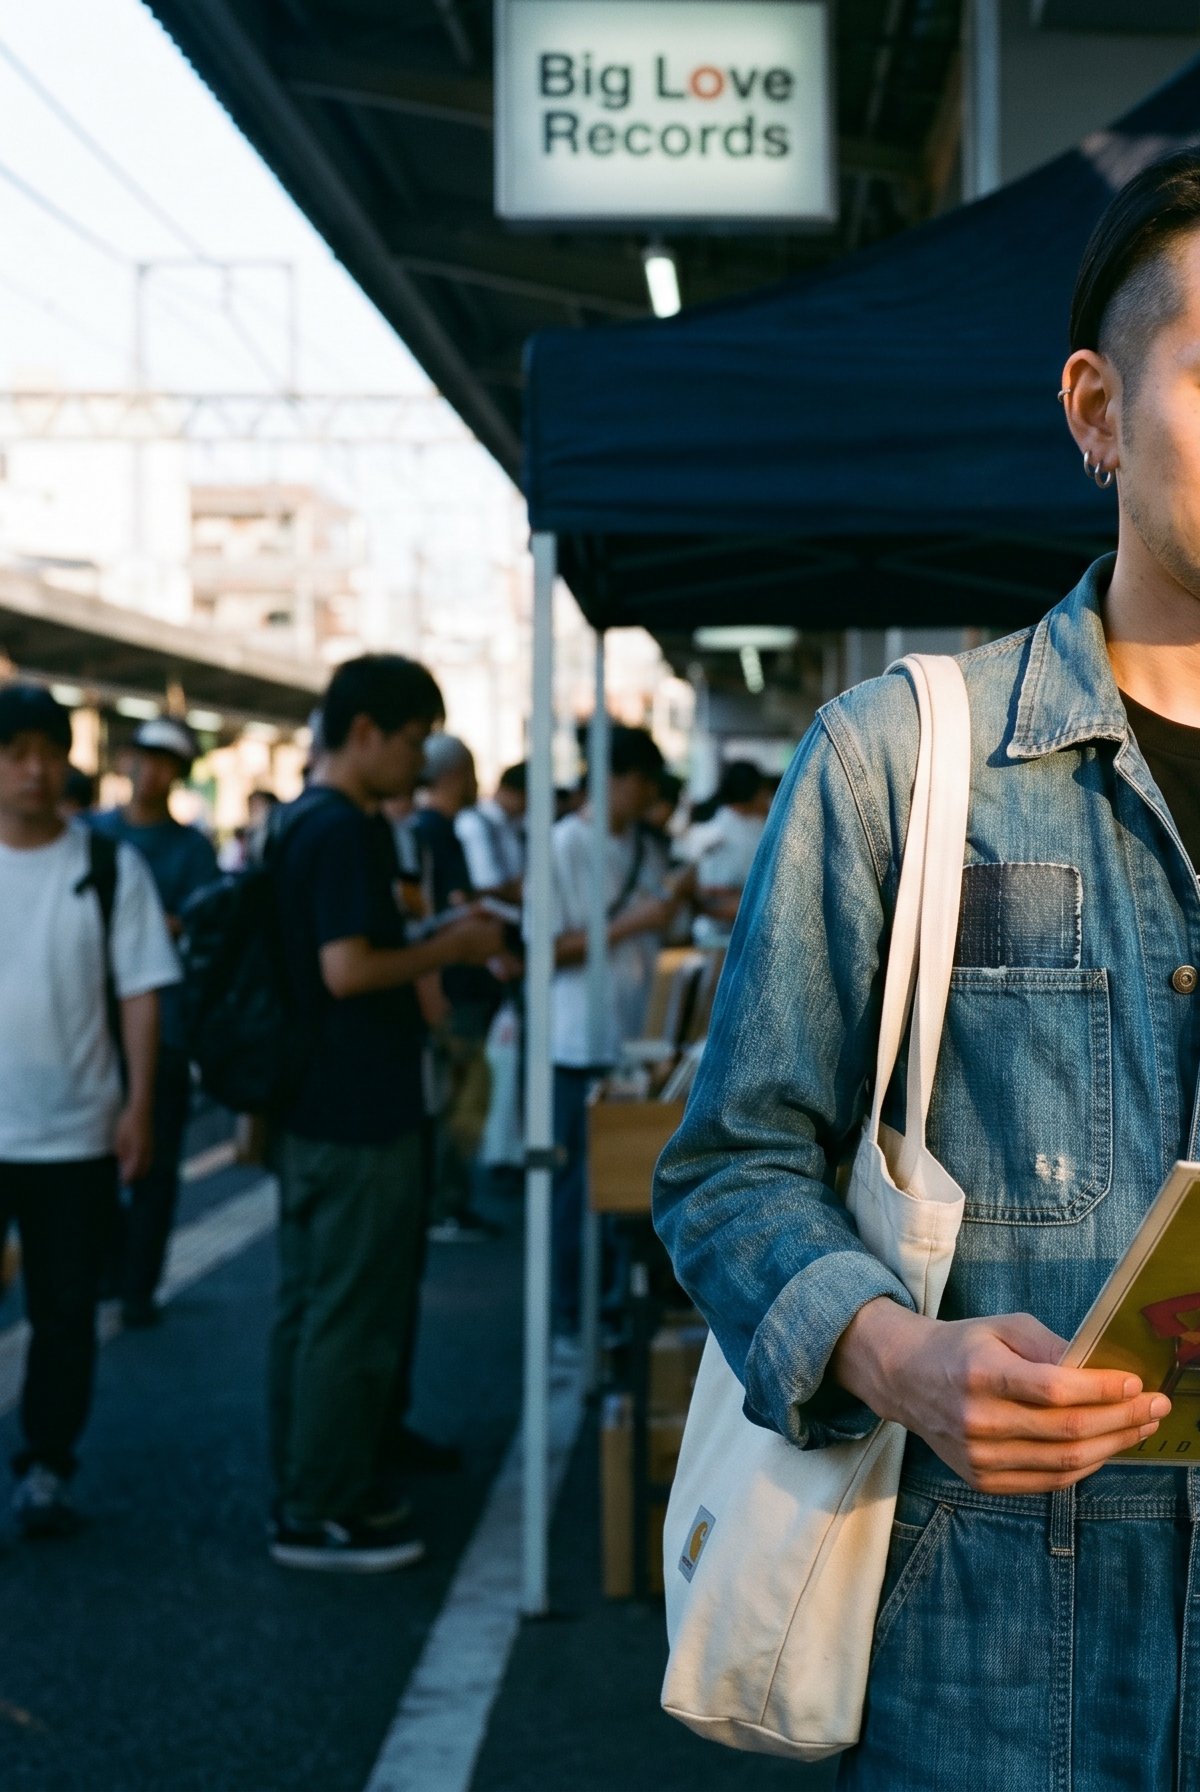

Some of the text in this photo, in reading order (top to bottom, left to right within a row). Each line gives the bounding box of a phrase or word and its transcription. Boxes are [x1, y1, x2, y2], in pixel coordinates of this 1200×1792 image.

[539, 53, 794, 111] Big Love
[543, 111, 790, 158] Records
